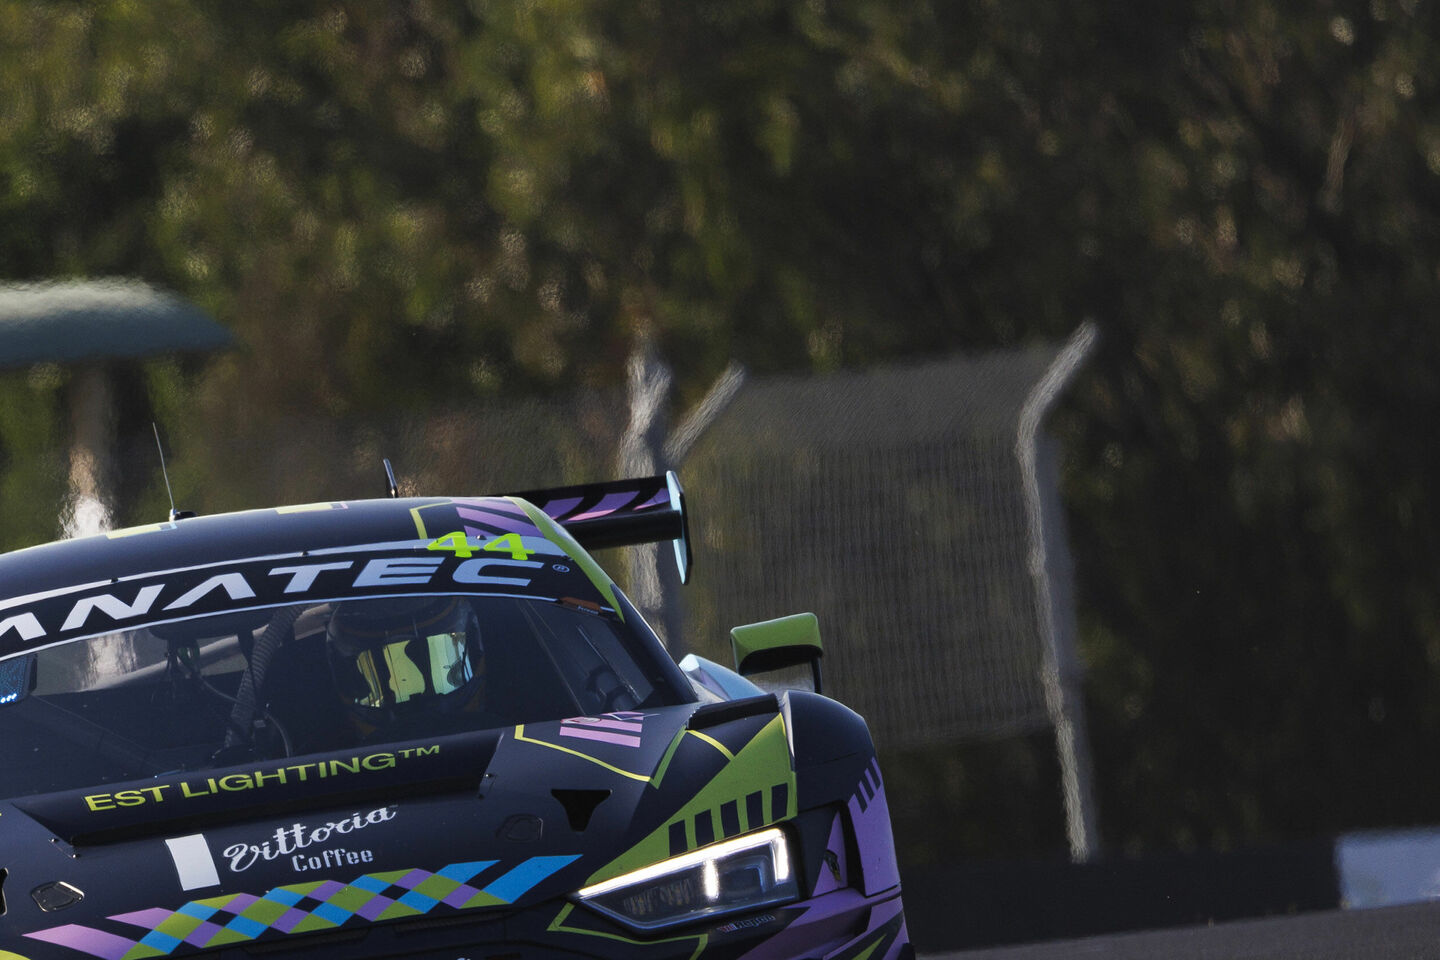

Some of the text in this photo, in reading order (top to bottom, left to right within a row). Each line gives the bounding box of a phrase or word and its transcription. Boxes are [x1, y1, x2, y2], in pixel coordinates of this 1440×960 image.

[426, 531, 535, 560] 44
[84, 784, 170, 812] EST
[222, 804, 399, 873] Vittoria
[291, 846, 374, 873] Coffee
